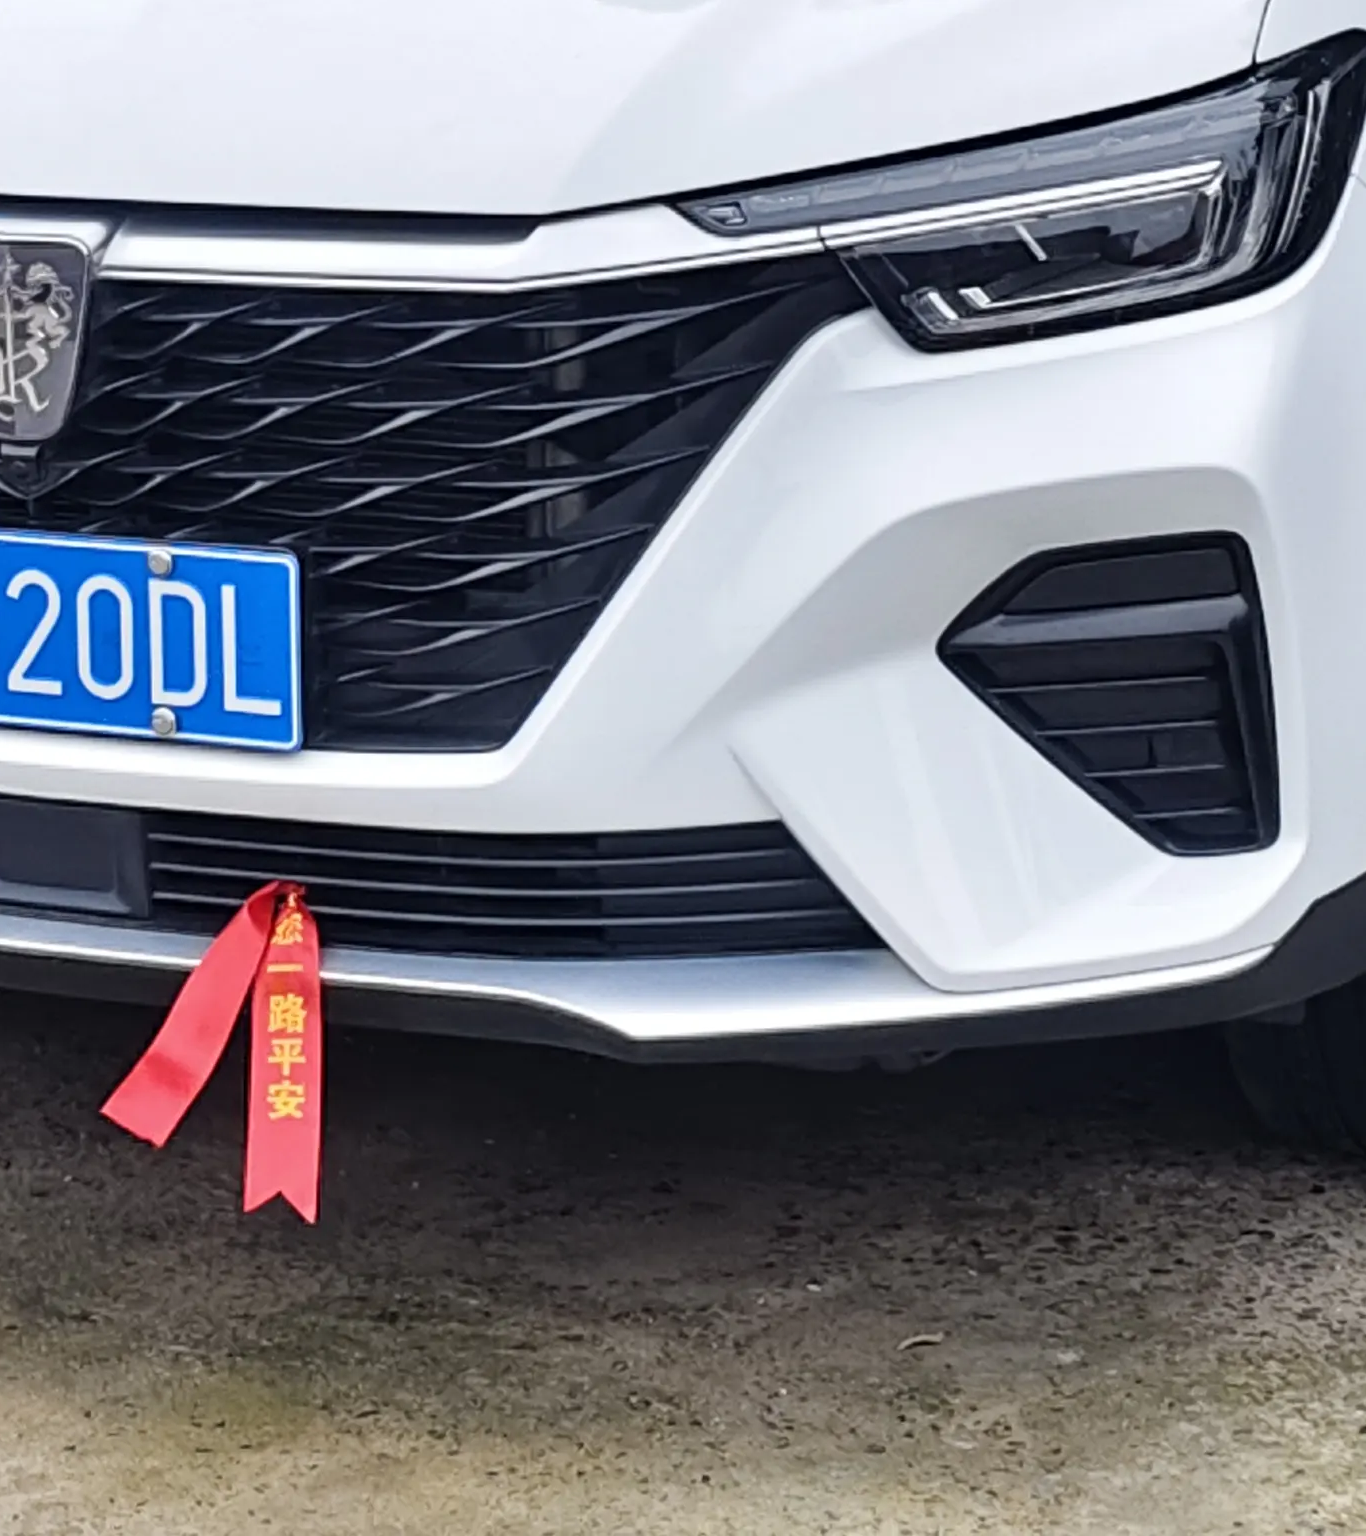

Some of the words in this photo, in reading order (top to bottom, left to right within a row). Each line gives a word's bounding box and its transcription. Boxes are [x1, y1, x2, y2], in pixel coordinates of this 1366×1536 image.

[266, 892, 308, 1121] 您一路平安
